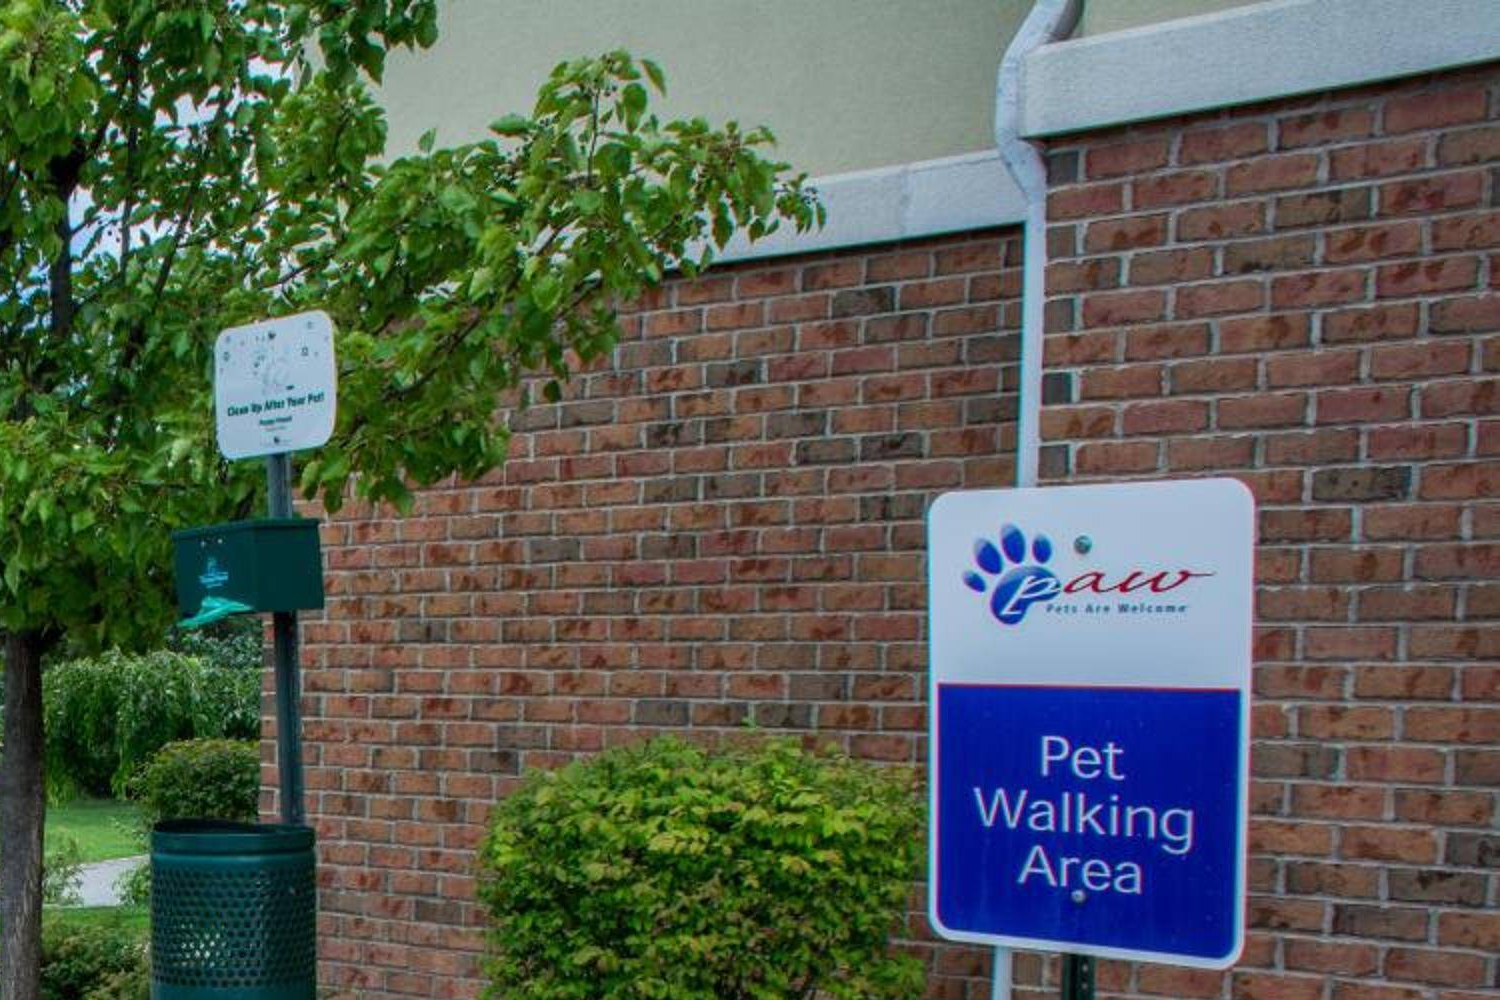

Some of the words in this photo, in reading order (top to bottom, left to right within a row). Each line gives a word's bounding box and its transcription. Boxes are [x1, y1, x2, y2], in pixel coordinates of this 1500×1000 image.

[1046, 603, 1078, 614] Pets
[1085, 603, 1110, 614] Are
[1118, 603, 1188, 615] Welcome
[1040, 735, 1125, 781] Pet
[973, 786, 1195, 855] Walking
[1016, 845, 1142, 895] Area
